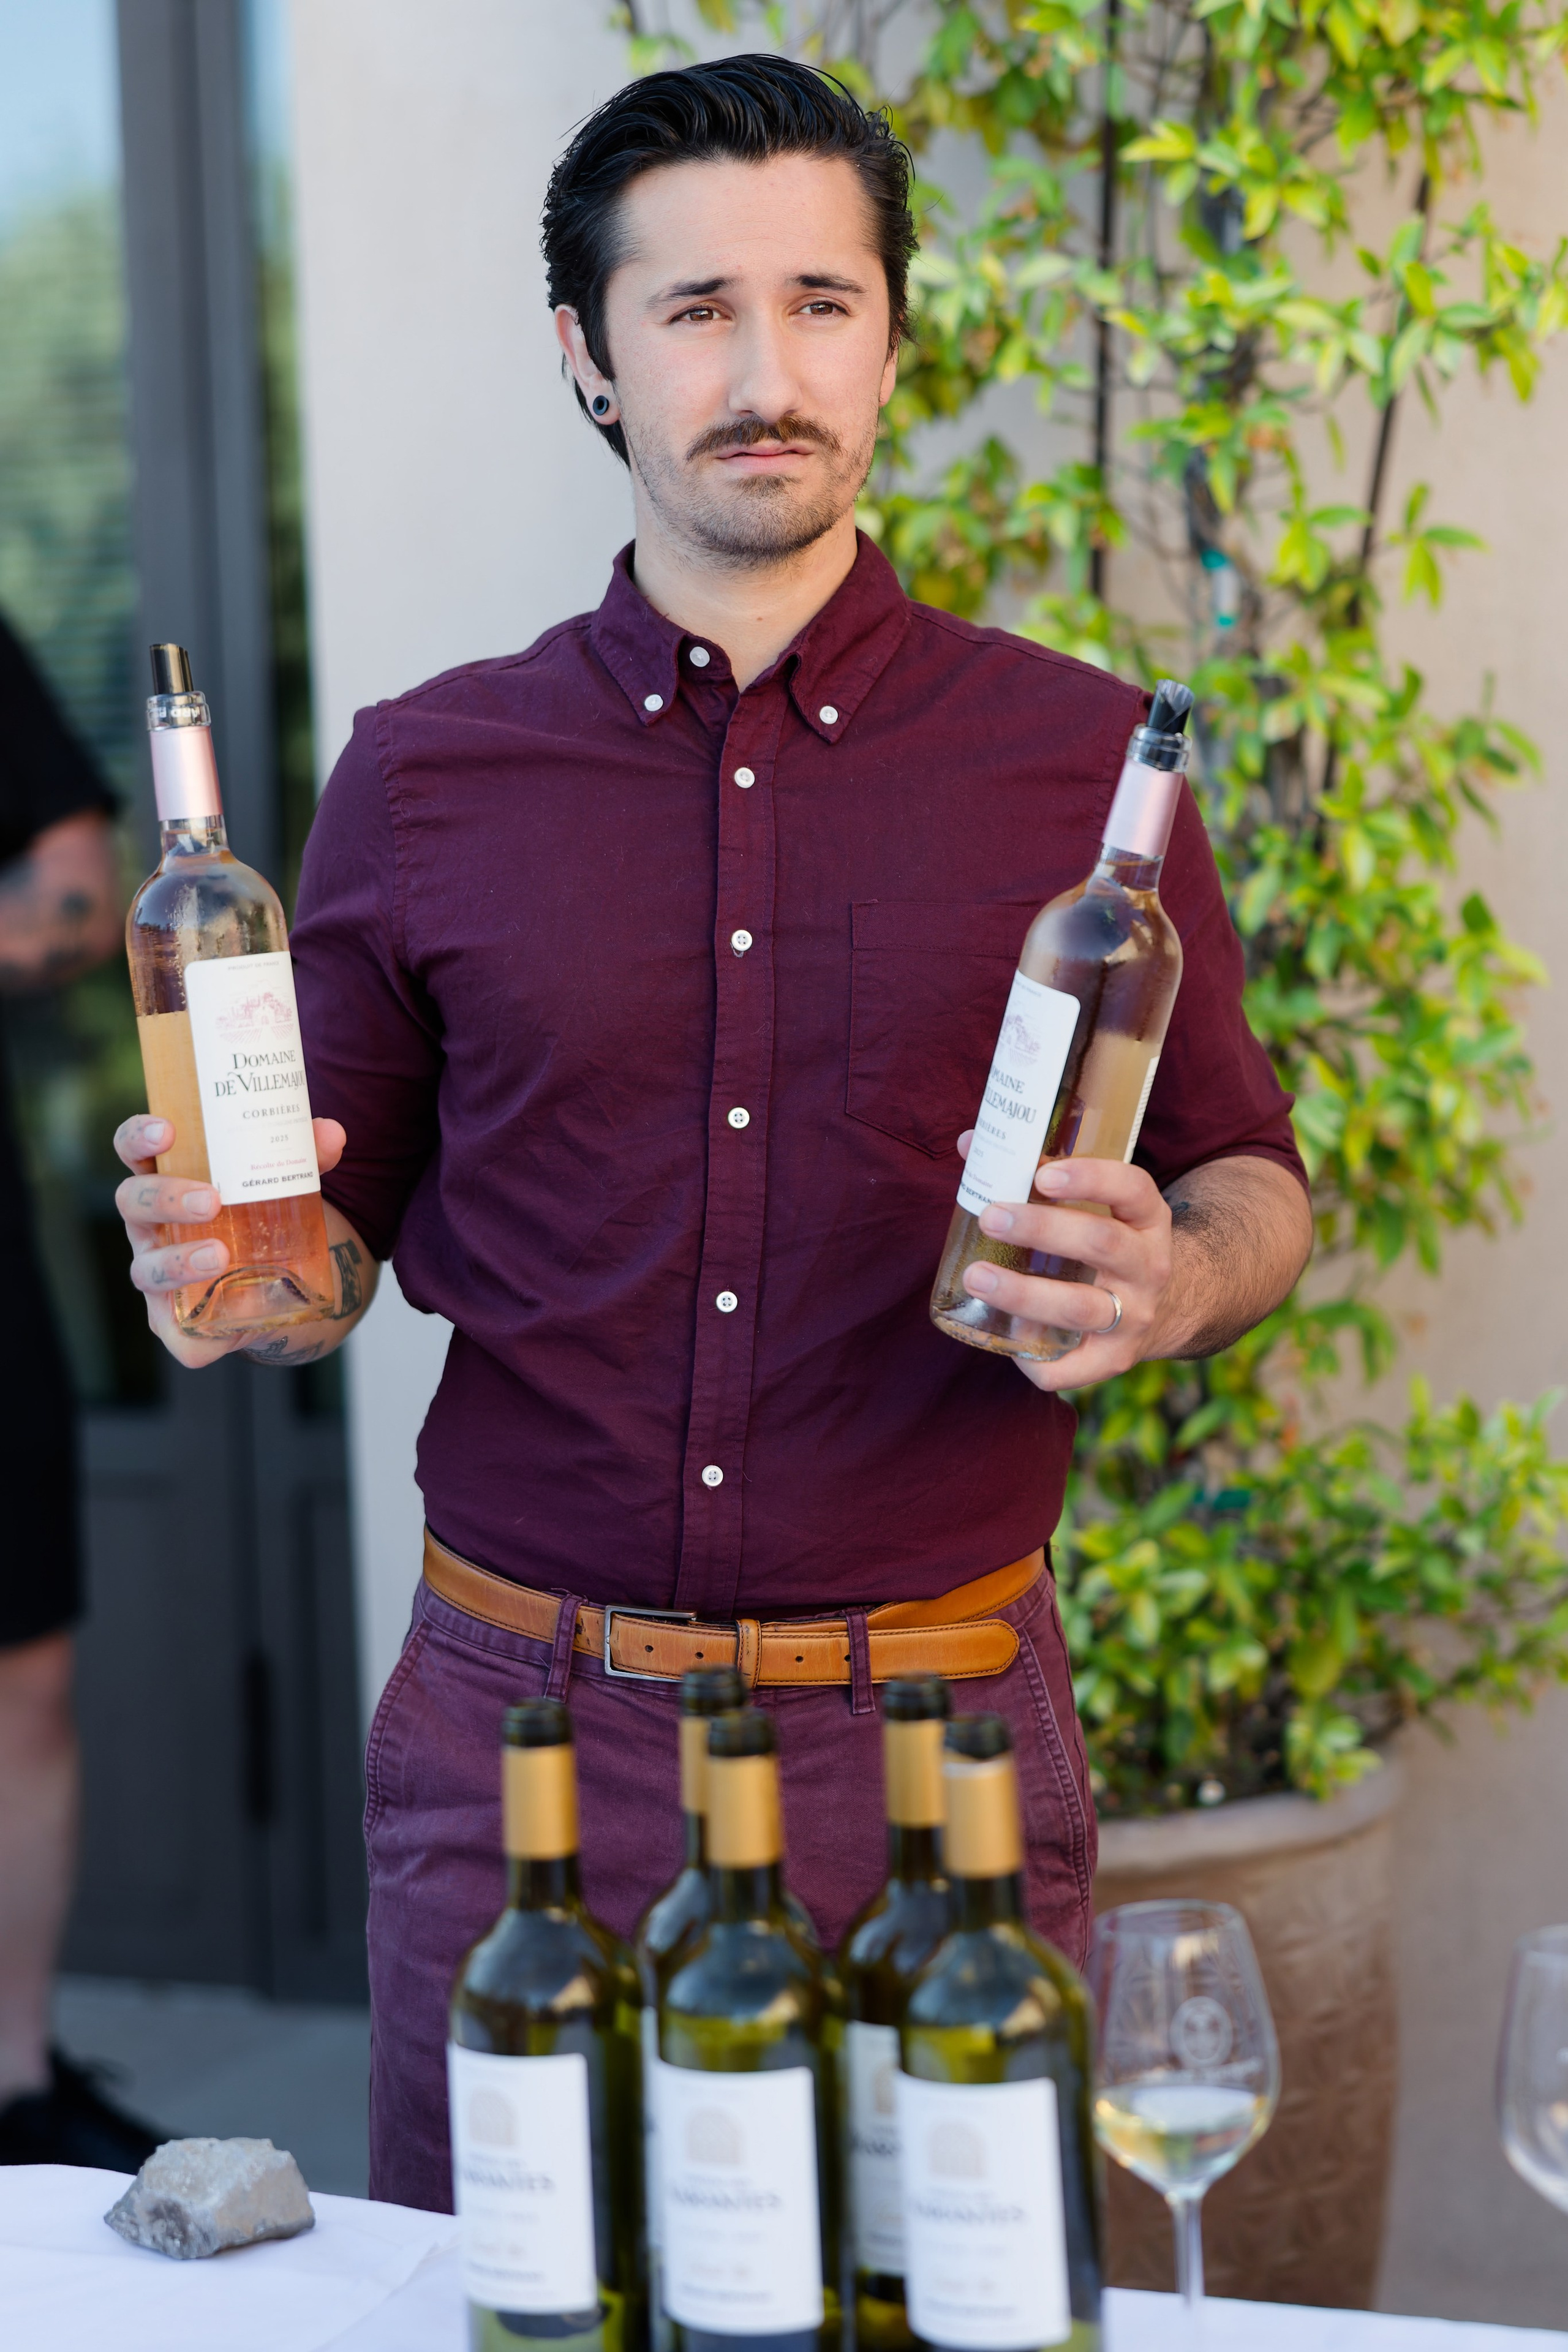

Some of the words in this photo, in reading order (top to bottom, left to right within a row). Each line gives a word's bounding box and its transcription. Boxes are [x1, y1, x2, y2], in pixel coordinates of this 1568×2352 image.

[232, 1050, 296, 1069] DOMAINE
[214, 1079, 237, 1097] DE
[990, 1065, 1026, 1094] MAINE
[243, 1103, 301, 1120] CORBIÈRES
[270, 1134, 289, 1144] 2025
[251, 1162, 276, 1171] Récolte
[242, 1177, 280, 1188] GÉRARD
[282, 1171, 314, 1182] BERTRAND
